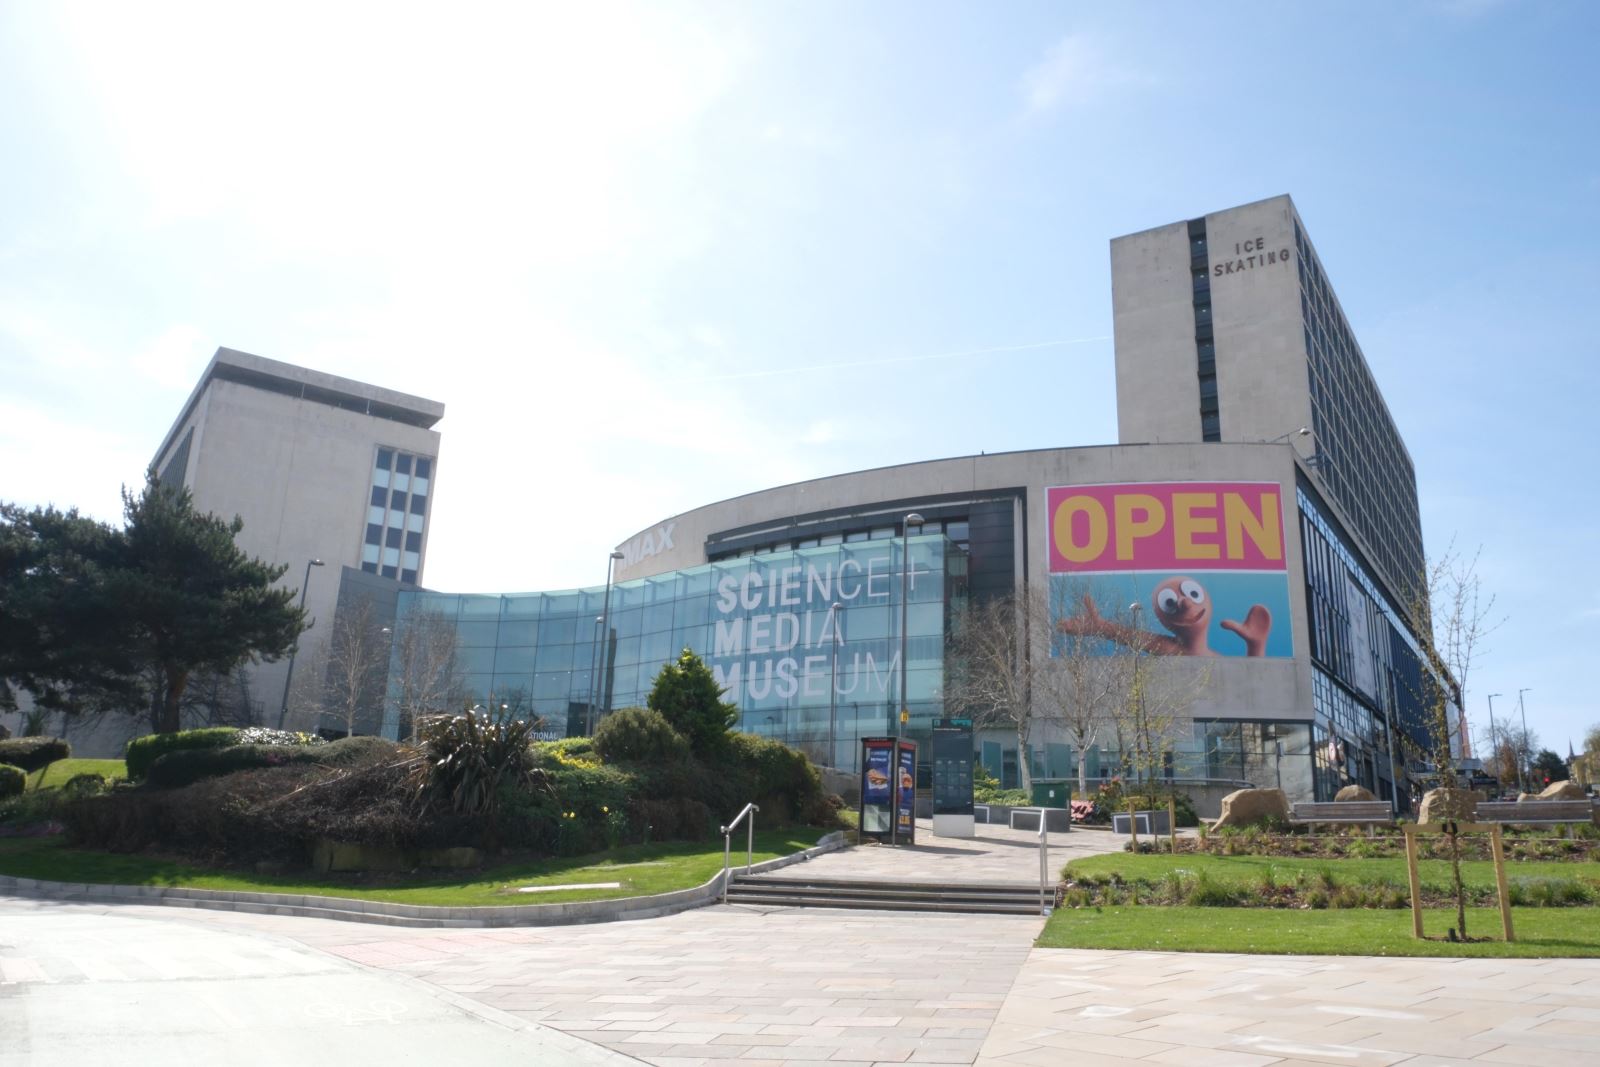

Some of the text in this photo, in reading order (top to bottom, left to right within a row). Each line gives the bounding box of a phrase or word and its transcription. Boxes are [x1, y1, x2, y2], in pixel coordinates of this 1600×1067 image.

[1214, 248, 1291, 277] SKATING
[1235, 237, 1265, 255] ICE
[1053, 492, 1282, 563] OPEN
[714, 607, 845, 658] MEDIA
[713, 650, 901, 701] MUSEUM
